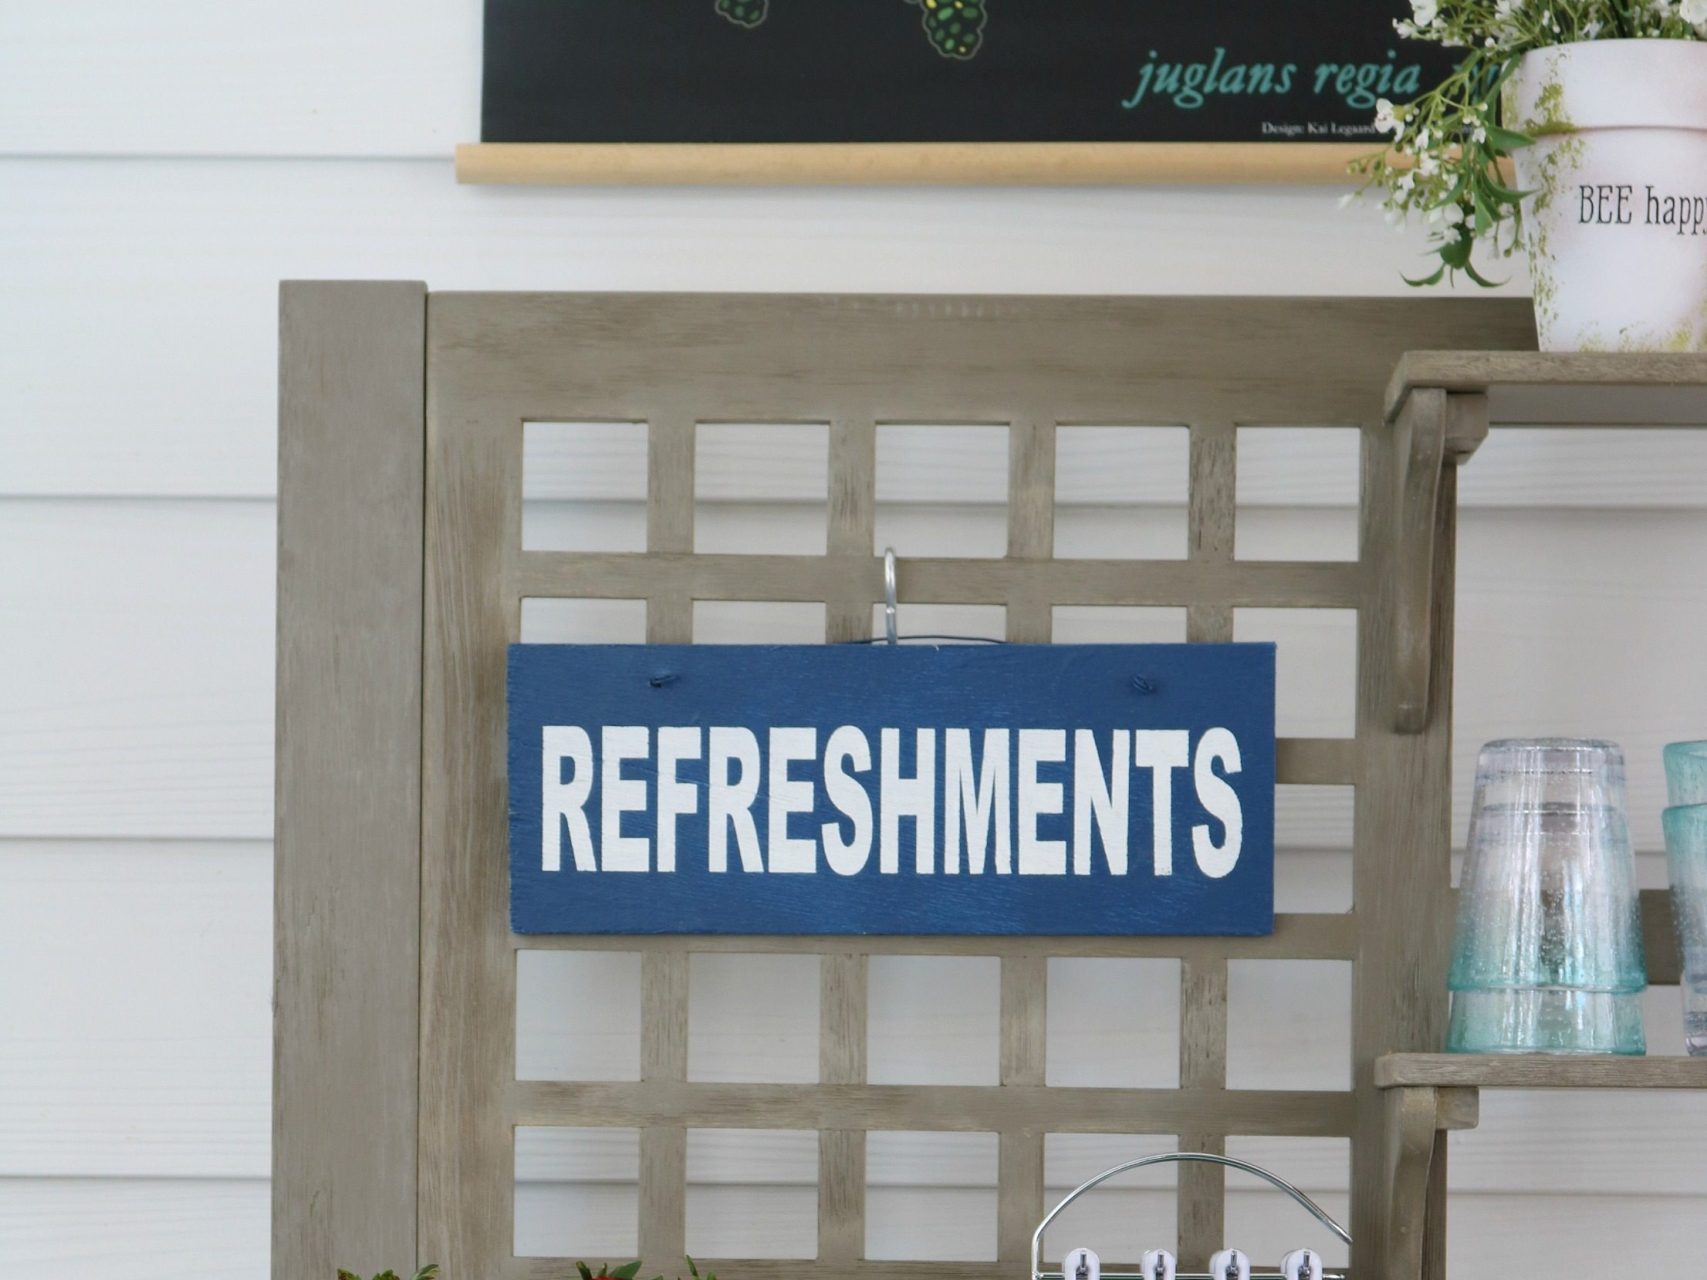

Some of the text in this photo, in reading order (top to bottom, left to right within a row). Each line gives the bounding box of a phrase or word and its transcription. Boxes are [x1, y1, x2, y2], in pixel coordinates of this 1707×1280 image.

[1121, 47, 1297, 110] juglans
[1313, 50, 1421, 110] regia
[1578, 184, 1707, 236] BEE happ
[541, 724, 1243, 878] REFRESHMENTS
